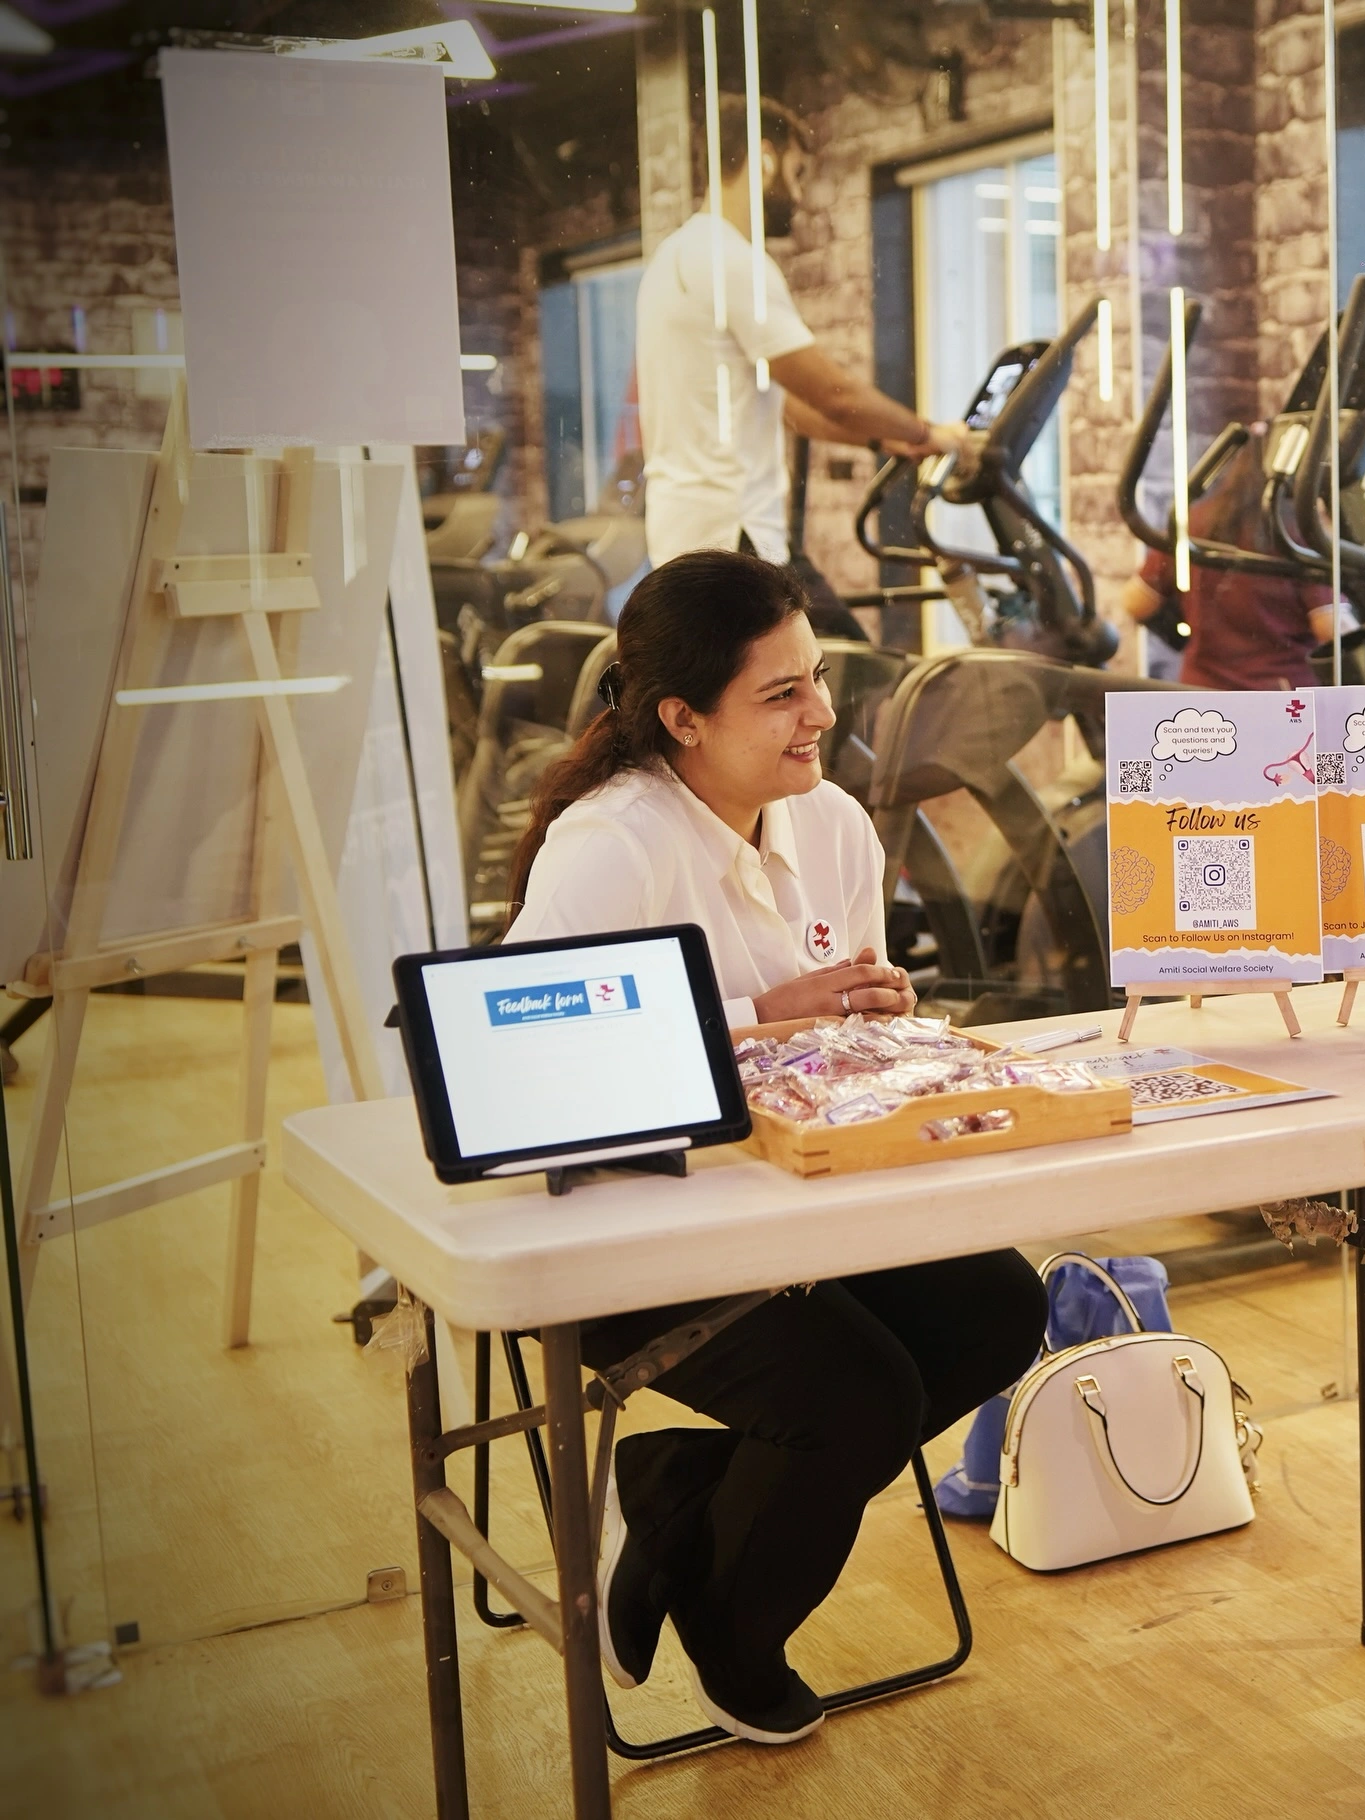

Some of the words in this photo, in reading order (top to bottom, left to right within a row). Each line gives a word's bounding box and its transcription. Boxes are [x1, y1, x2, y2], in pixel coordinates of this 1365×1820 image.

[1163, 726, 1183, 734] Scan
[1216, 727, 1234, 736] your
[1171, 736, 1209, 746] questions
[1210, 736, 1226, 744] and
[1182, 747, 1213, 756] queries!
[1166, 807, 1227, 832] Follow
[1234, 812, 1261, 831] us
[1192, 919, 1239, 929] @AMITI_AWS
[1323, 922, 1347, 930] Scan
[1349, 921, 1359, 930] to
[1142, 935, 1167, 943] Scan
[1169, 934, 1179, 942] to
[1181, 933, 1211, 942] Follow
[1213, 933, 1226, 942] Us
[1242, 932, 1295, 943] Instagram!
[1158, 966, 1181, 974] Amiti
[1182, 966, 1208, 974] Social
[1209, 965, 1242, 973] Welfare
[1243, 964, 1274, 974] Society
[497, 993, 552, 1016] Feedback
[555, 992, 585, 1010] form
